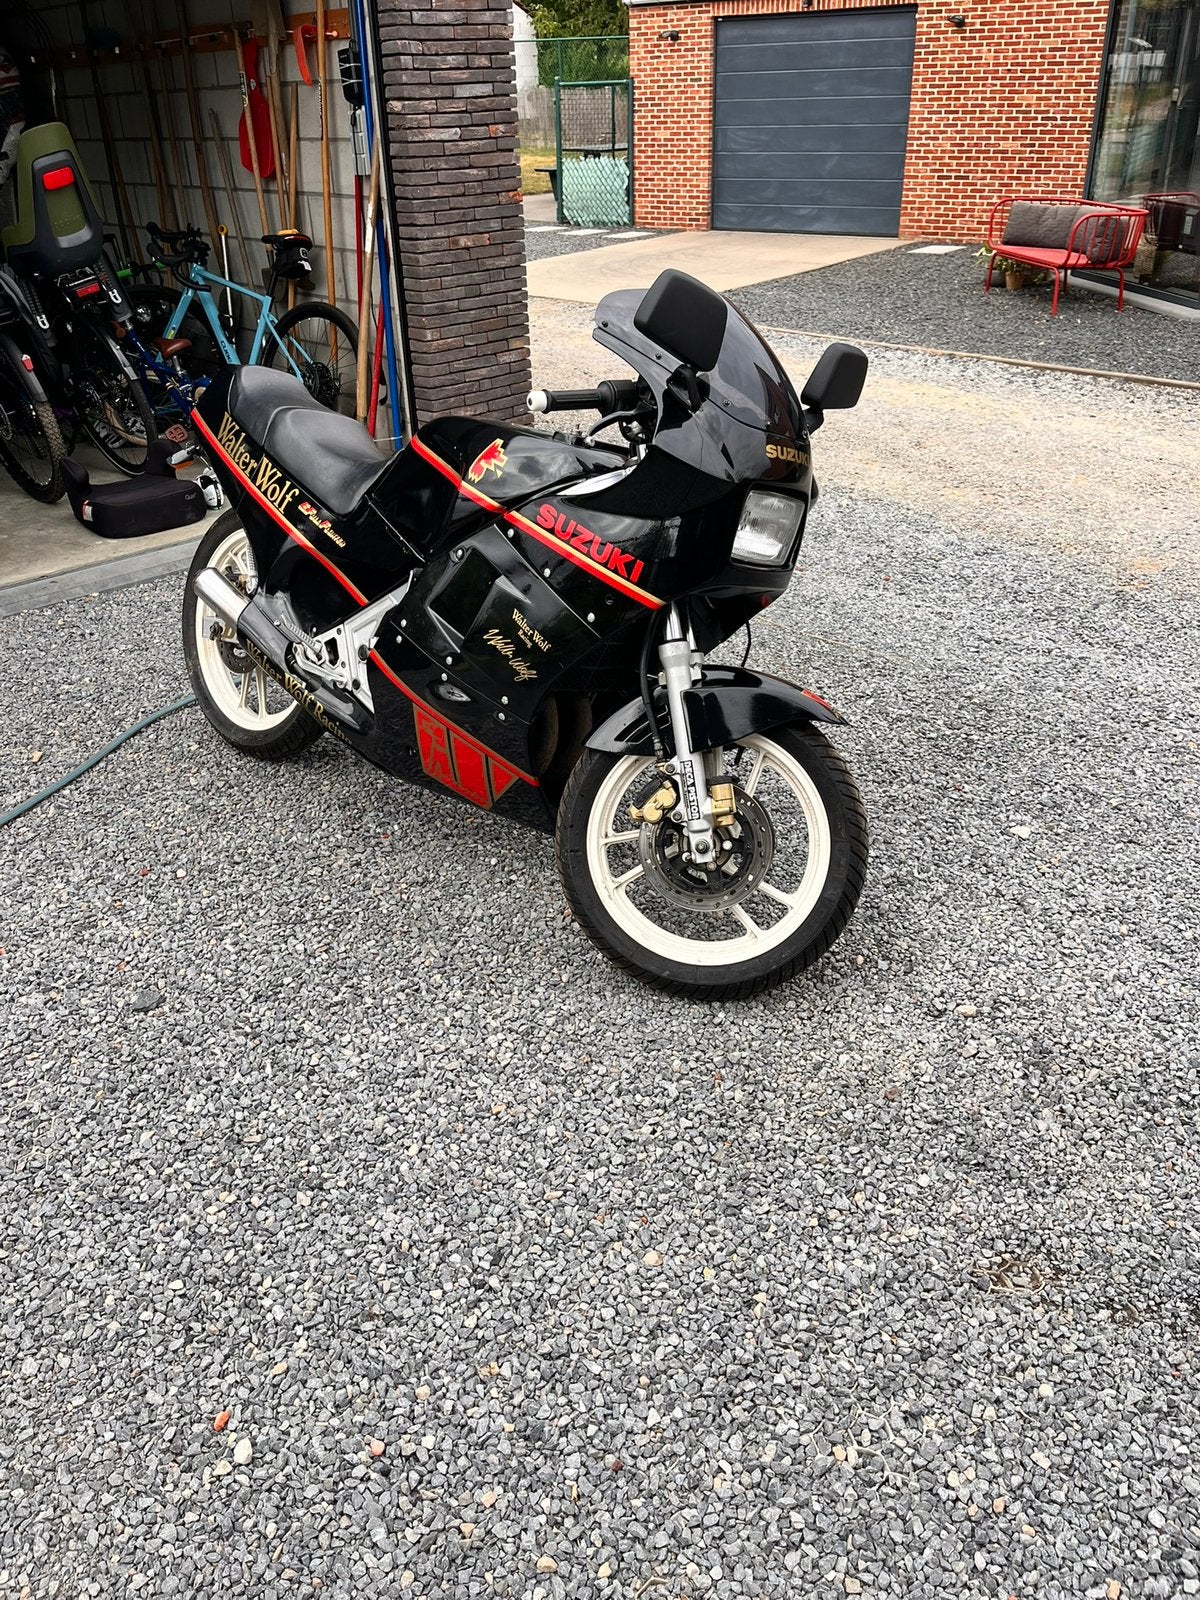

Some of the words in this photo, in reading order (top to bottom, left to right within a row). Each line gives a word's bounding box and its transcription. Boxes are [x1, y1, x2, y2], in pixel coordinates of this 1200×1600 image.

[218, 411, 257, 477] Walter
[256, 456, 299, 514] Wolf
[765, 443, 811, 467] SUZUKI
[536, 503, 644, 584] SUZUKI
[512, 607, 534, 636] Walter
[532, 629, 552, 653] Wolf
[245, 638, 282, 682] Walter
[284, 672, 315, 707] Wolf
[683, 761, 695, 786] DECA
